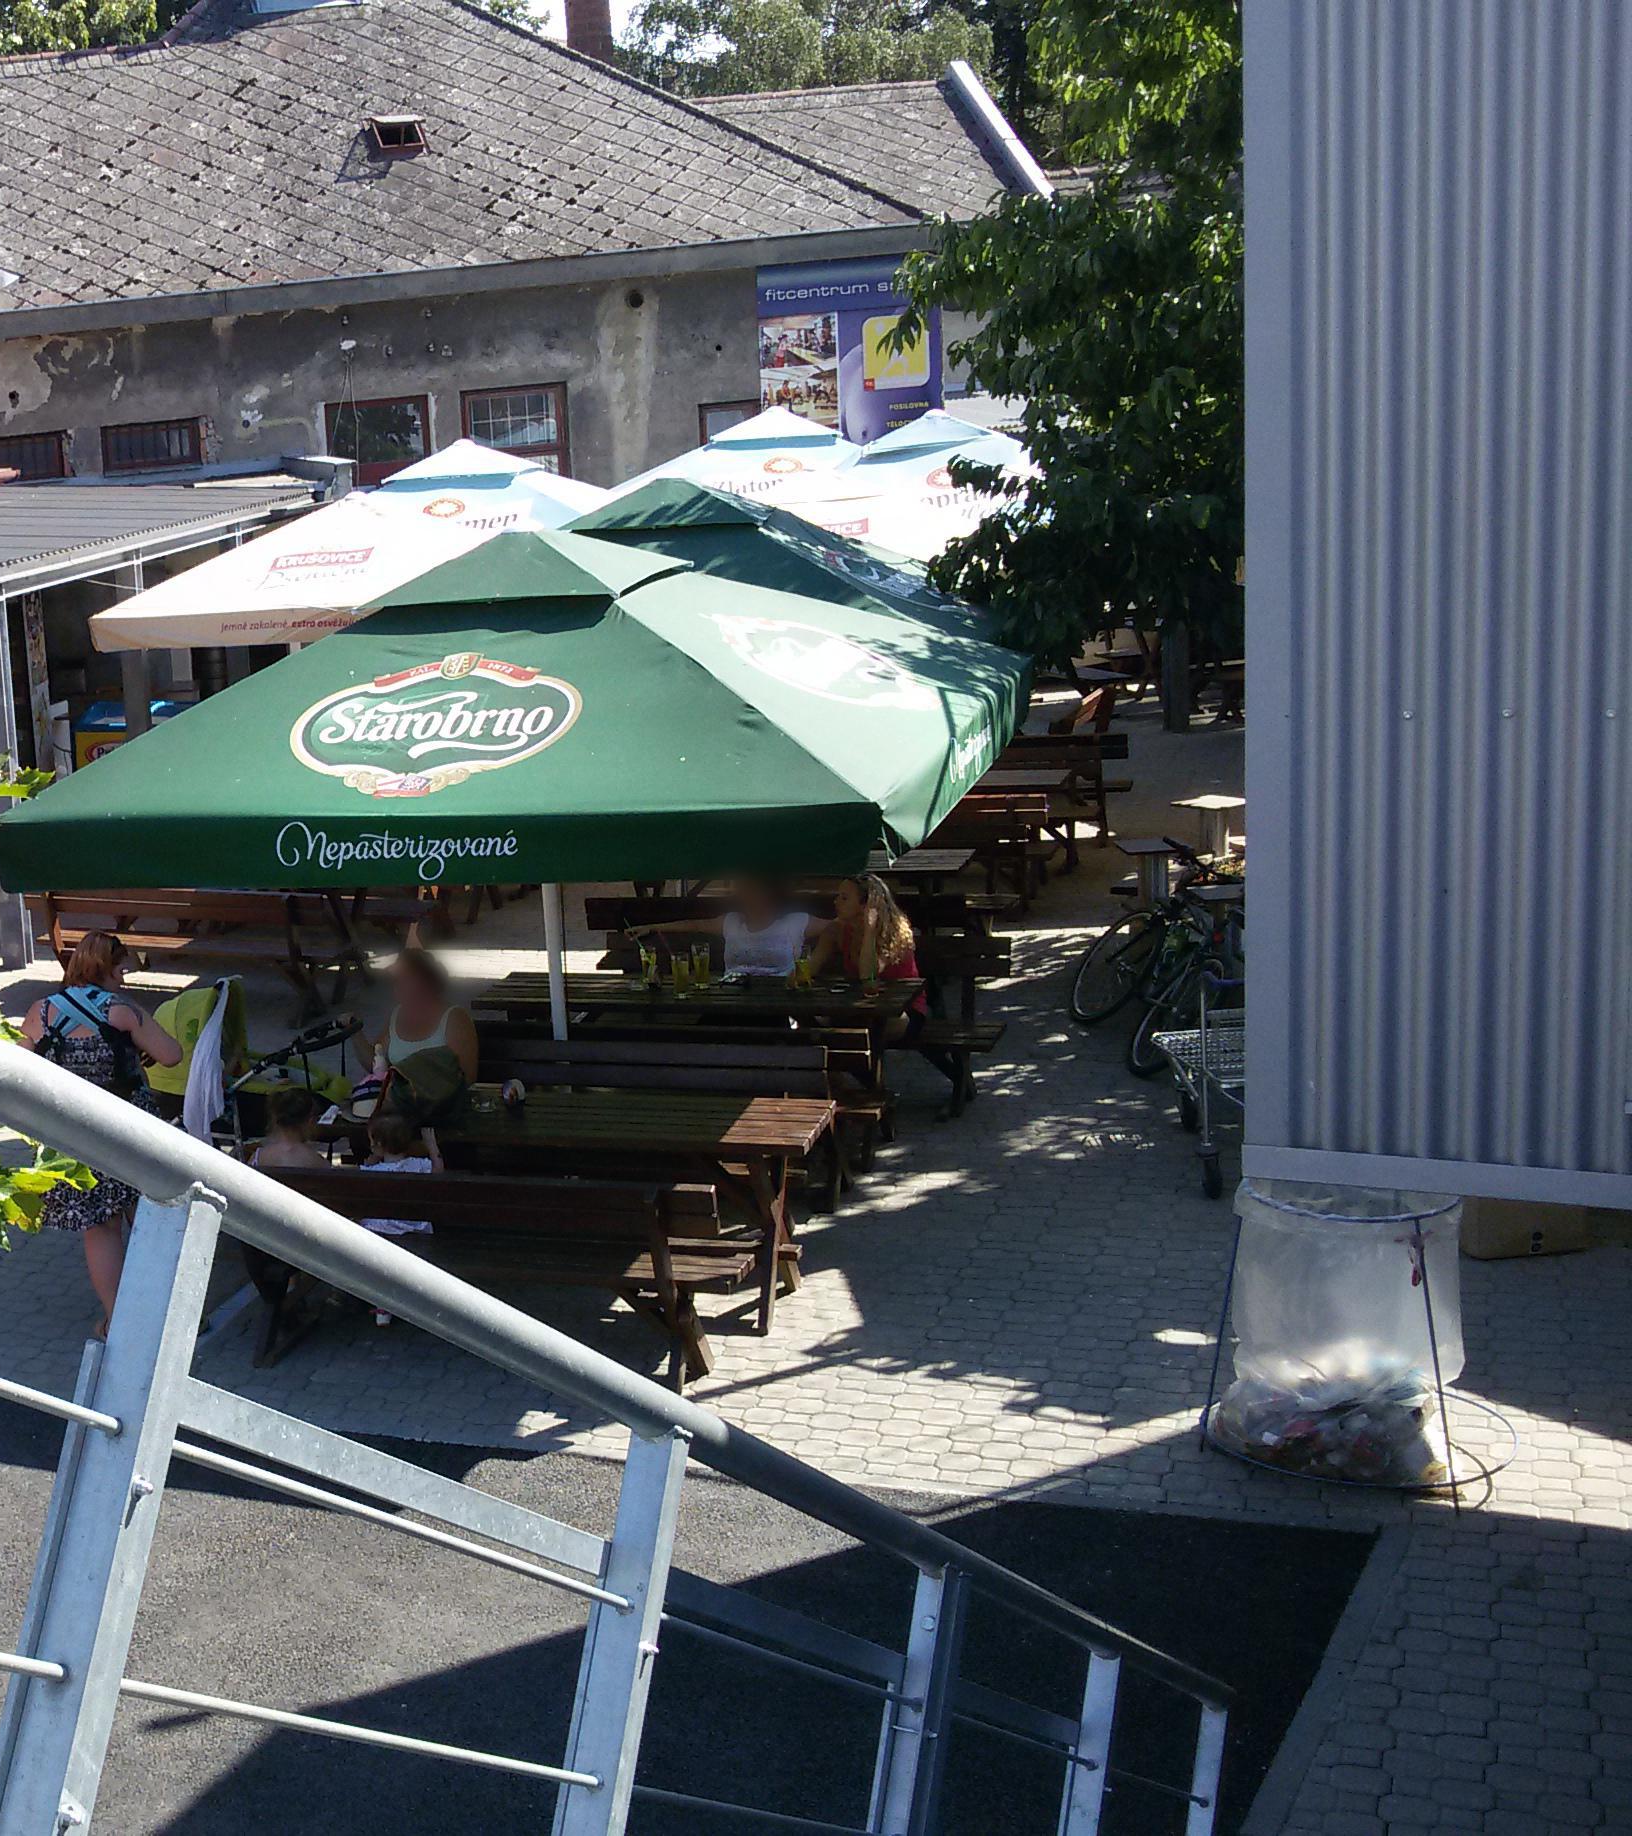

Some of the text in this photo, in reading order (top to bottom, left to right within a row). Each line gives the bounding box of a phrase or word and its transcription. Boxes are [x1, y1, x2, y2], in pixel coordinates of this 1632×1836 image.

[765, 283, 869, 301] fitcentrum
[889, 401, 929, 411] POSILOVNA
[291, 619, 316, 628] extra
[319, 691, 555, 759] Starobrno
[276, 821, 519, 880] Nepasterizované
